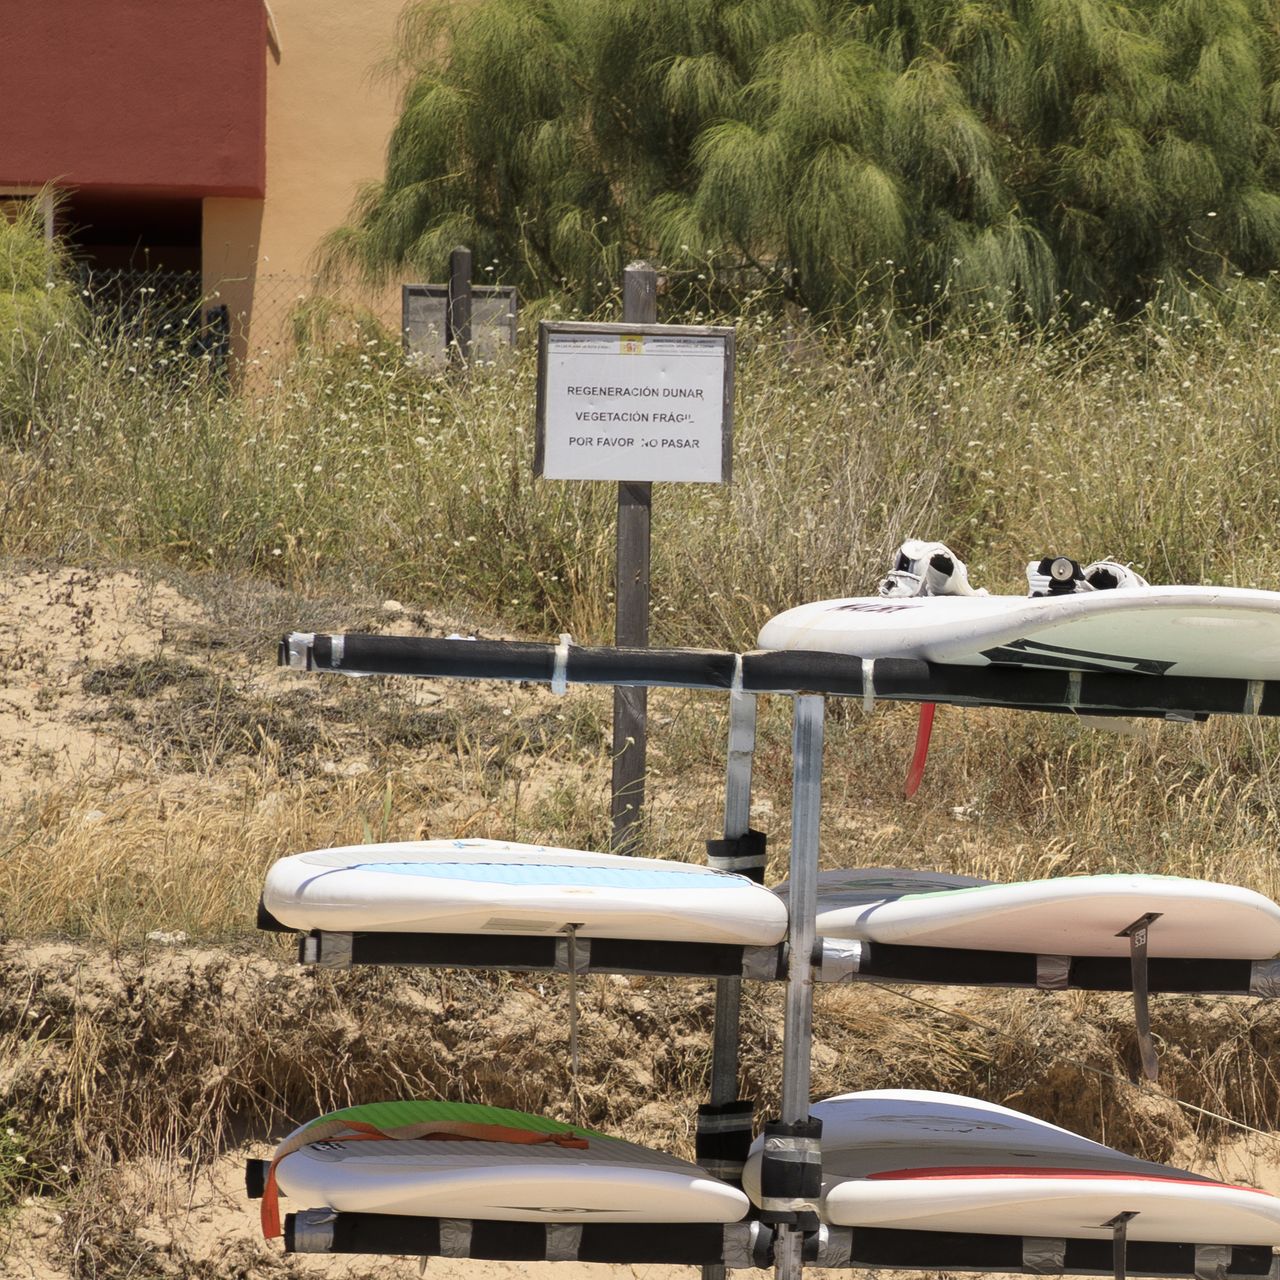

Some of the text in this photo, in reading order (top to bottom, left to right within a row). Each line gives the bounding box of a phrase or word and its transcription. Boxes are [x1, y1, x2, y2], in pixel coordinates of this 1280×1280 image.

[567, 386, 704, 400] REGENERACIÓN DUNAR
[575, 411, 649, 423] VEGETACIÓN
[569, 436, 594, 446] POR
[597, 437, 634, 447] FAVOR
[661, 439, 700, 449] PASAR
